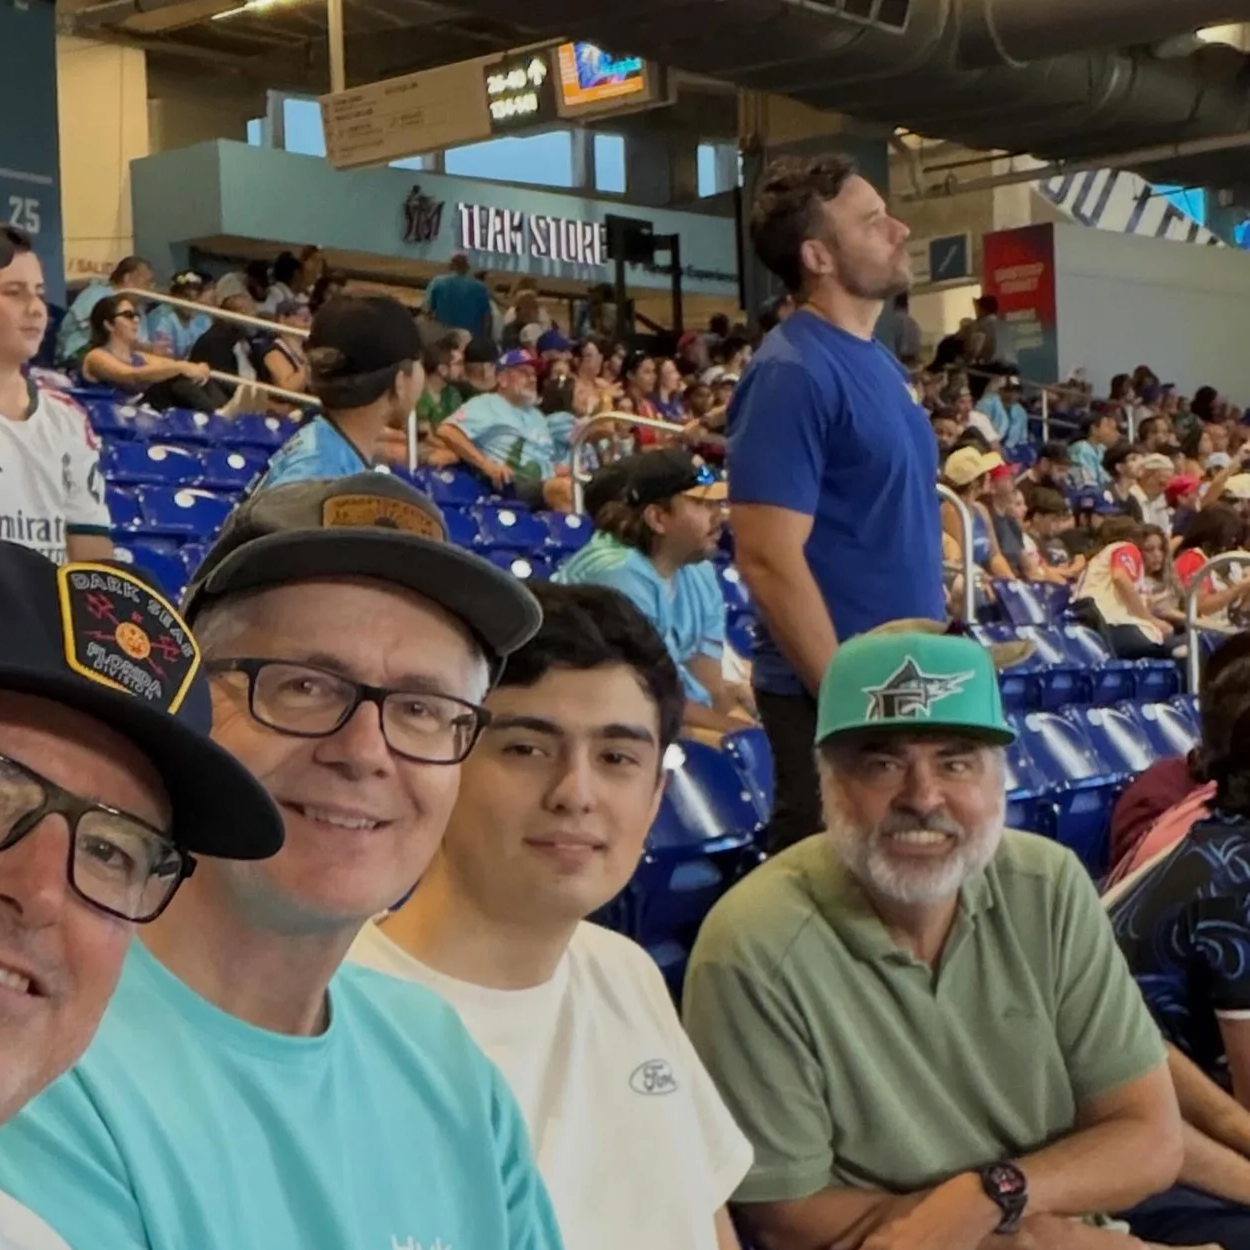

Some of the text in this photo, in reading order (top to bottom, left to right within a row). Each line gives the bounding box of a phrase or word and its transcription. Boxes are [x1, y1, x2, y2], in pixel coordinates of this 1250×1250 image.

[8, 195, 41, 234] 25
[457, 201, 607, 266] TEAM STORE
[70, 572, 194, 658] DARK SEAS
[643, 1064, 677, 1092] Ford
